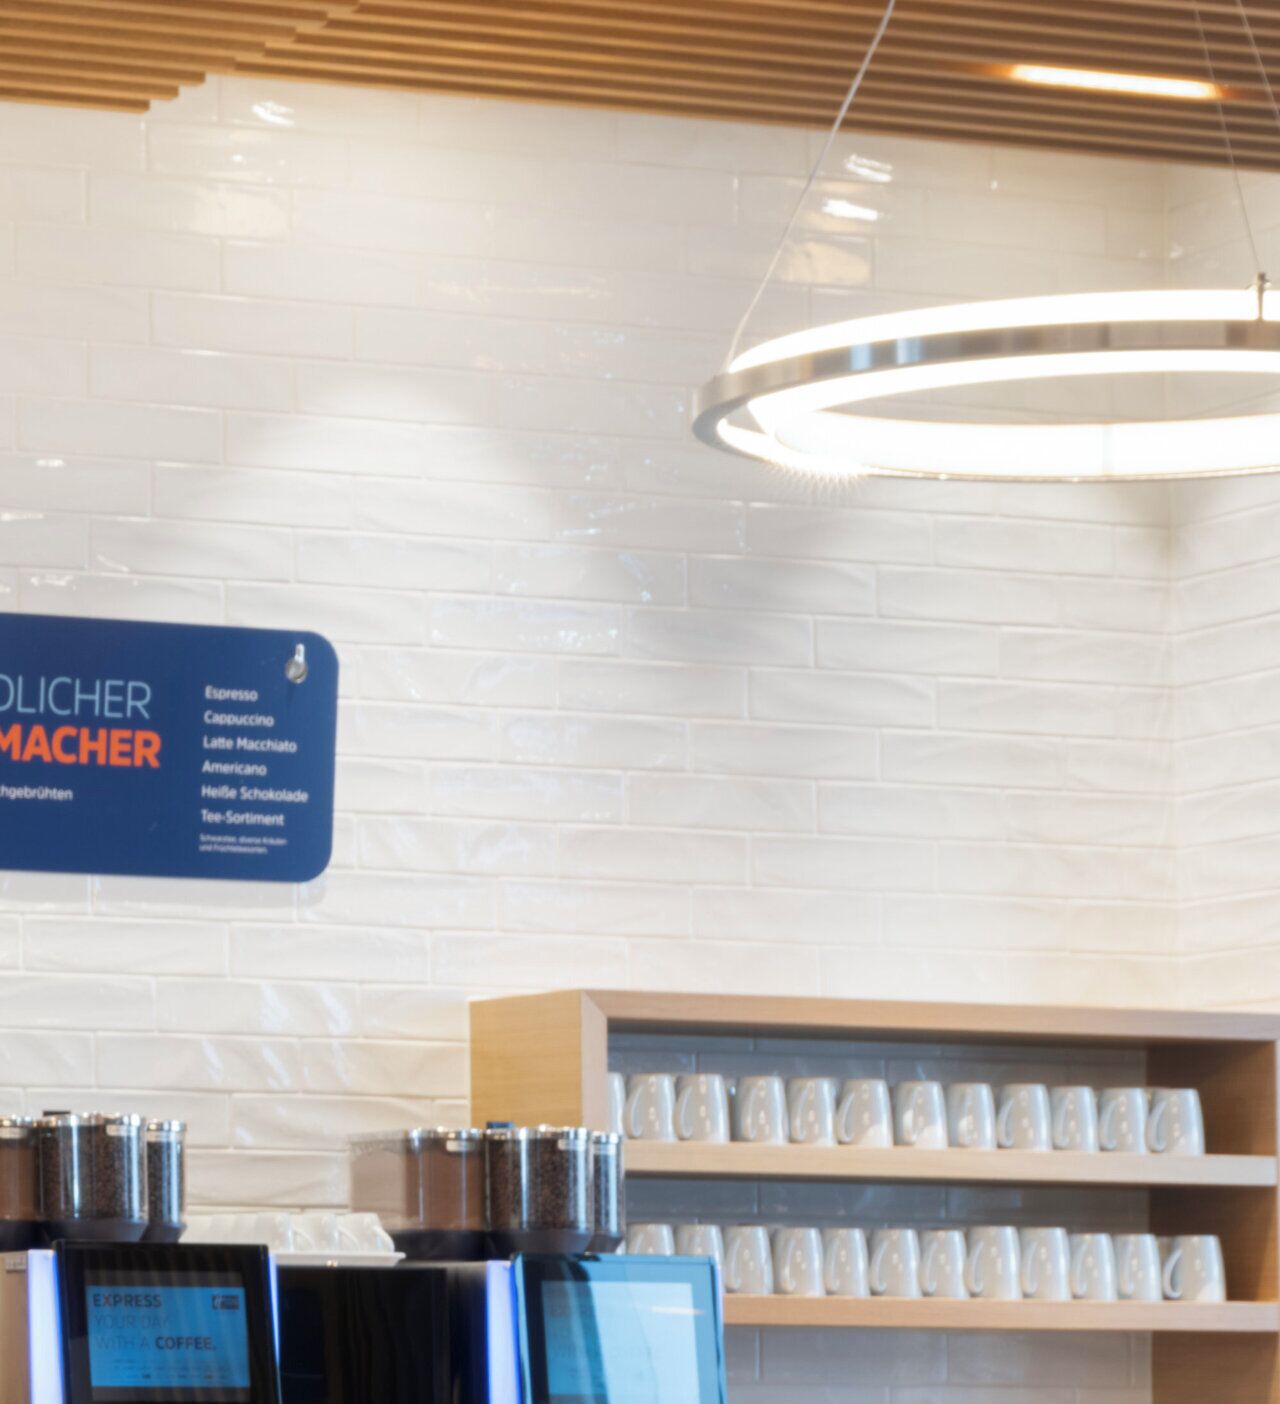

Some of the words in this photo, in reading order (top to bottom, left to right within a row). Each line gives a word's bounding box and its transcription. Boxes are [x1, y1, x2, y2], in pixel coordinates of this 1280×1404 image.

[205, 685, 258, 701] Espresso
[204, 710, 274, 727] Cappuccino
[203, 735, 234, 750] Latte
[237, 737, 297, 753] Macchiato
[202, 760, 267, 776] Americano
[201, 784, 237, 799] Heiße
[240, 786, 308, 802] Schokolade
[201, 809, 284, 826] Tee-Sortiment
[93, 1293, 162, 1308] EXPRESS
[94, 1315, 137, 1329] YOUR
[95, 1337, 135, 1350] WITH
[141, 1337, 151, 1350] A
[156, 1336, 216, 1351] COFFEE.
